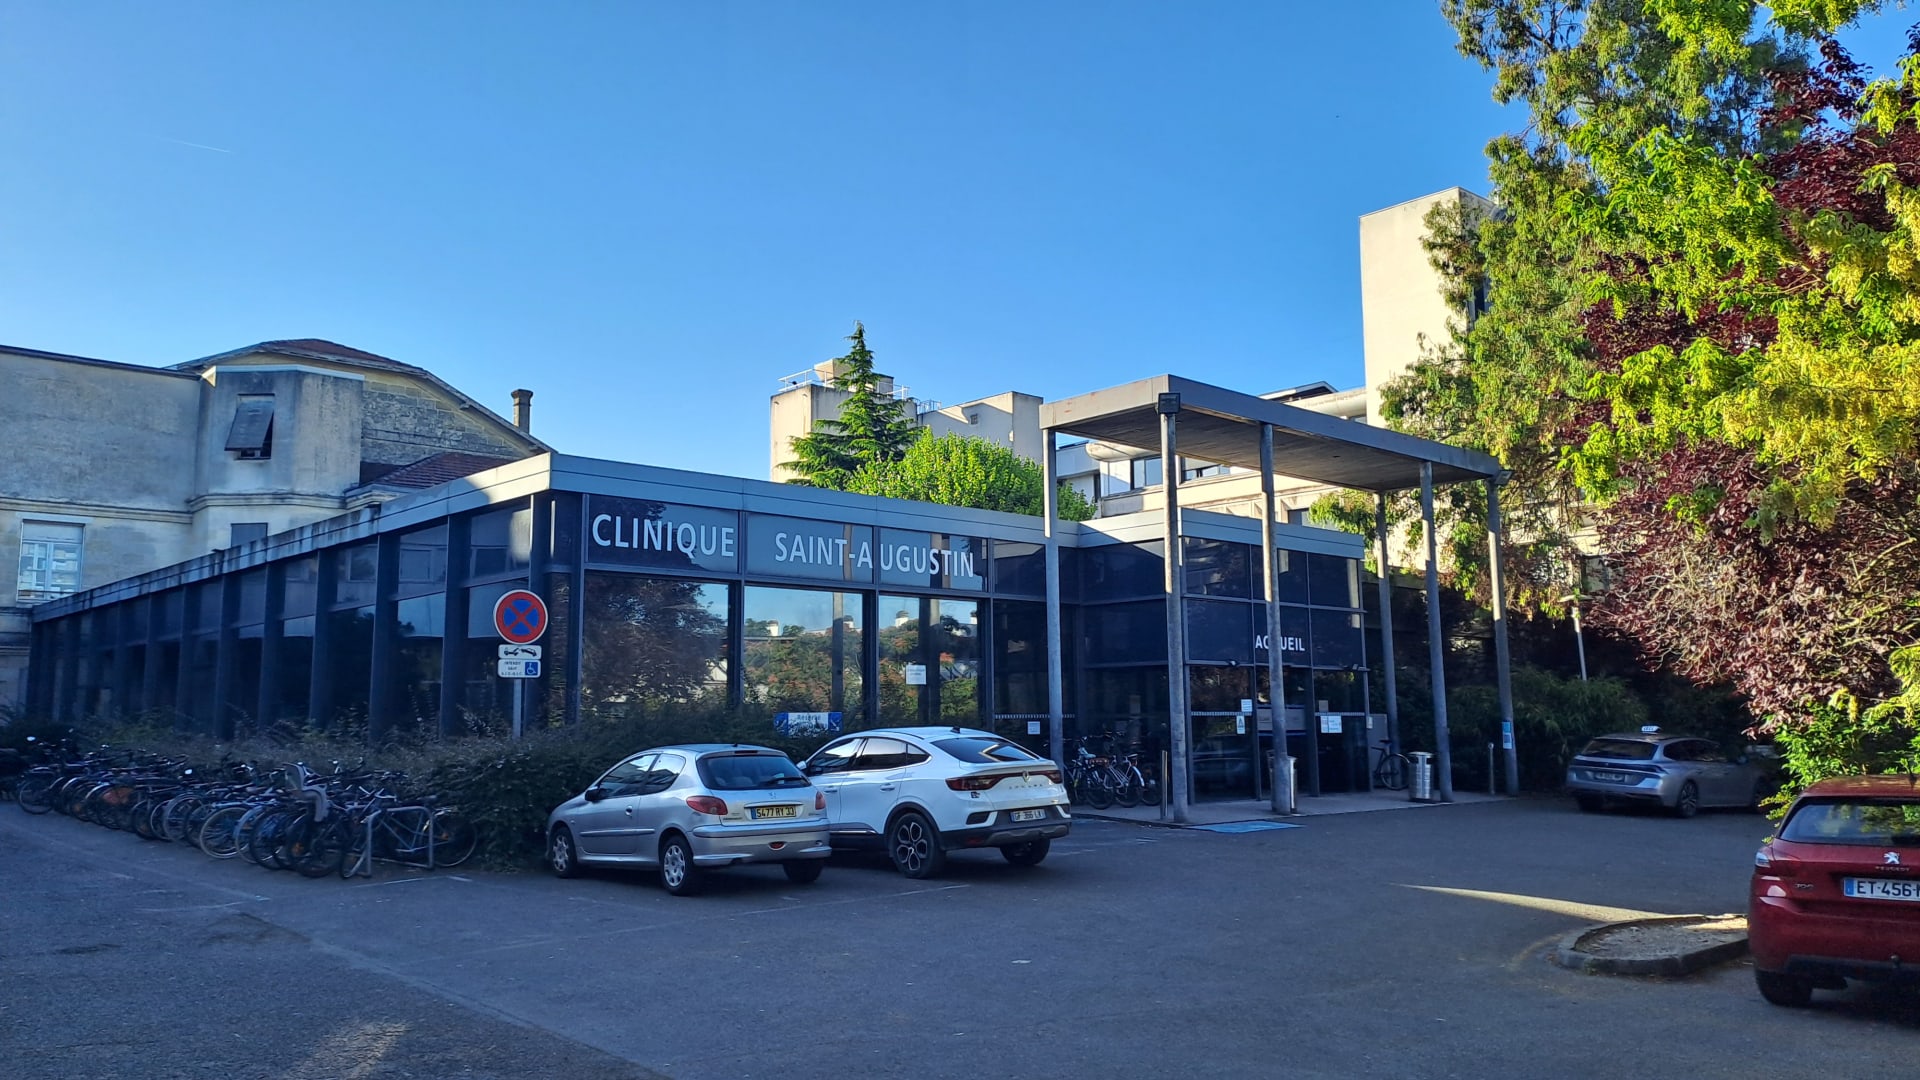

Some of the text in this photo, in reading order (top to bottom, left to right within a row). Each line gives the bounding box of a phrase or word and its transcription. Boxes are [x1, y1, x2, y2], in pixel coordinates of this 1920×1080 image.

[592, 514, 734, 559] CLINIQUE
[1255, 635, 1305, 651] ACUEIL
[756, 806, 795, 817] 5477 RY 33
